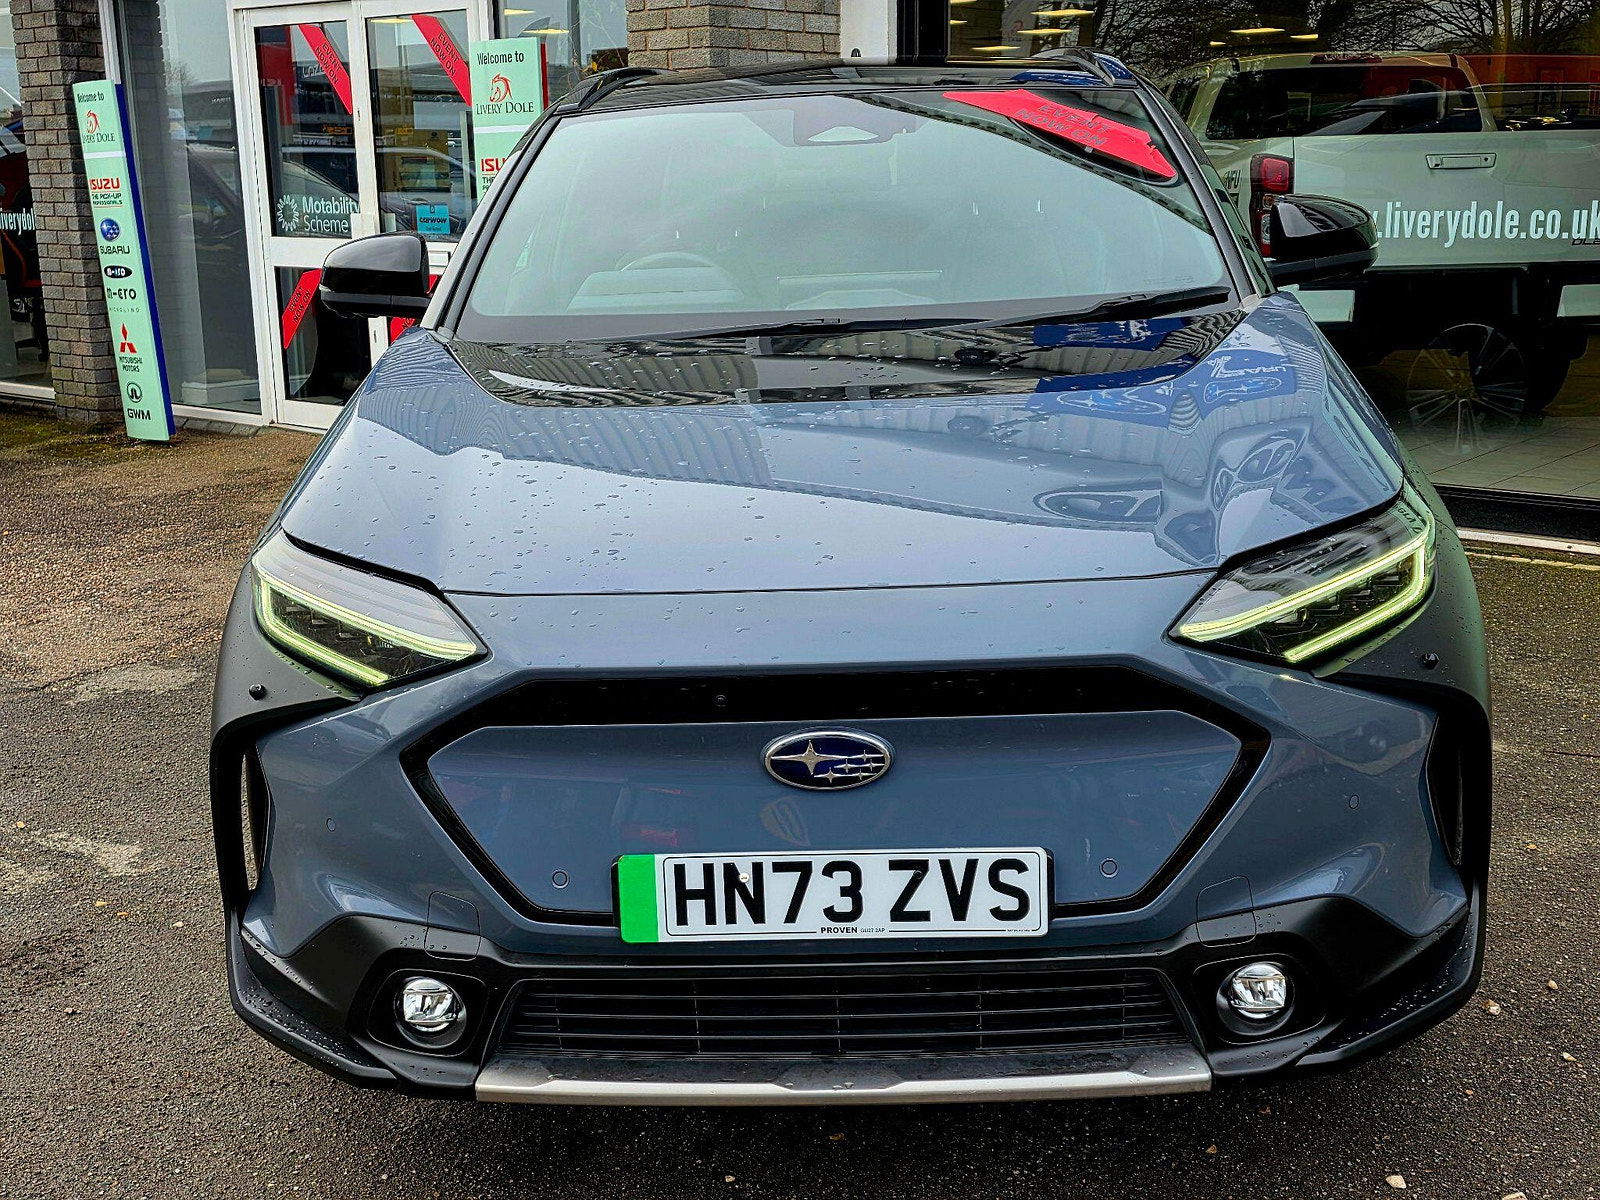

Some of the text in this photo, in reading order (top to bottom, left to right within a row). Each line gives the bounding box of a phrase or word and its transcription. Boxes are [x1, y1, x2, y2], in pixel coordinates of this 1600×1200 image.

[322, 43, 341, 71] EVENT
[430, 38, 456, 76] NOW ON
[438, 32, 460, 63] EVENT
[477, 50, 525, 65] Welcome to
[315, 47, 339, 84] NOW ON
[476, 102, 535, 115] LIVERY DOLE
[1038, 104, 1112, 132] EVENT
[1015, 108, 1110, 146] NOW ON
[302, 196, 360, 214] Motability
[303, 214, 349, 233] Scheme
[100, 245, 130, 255] SUBARU
[127, 408, 151, 420] GWM
[673, 858, 1030, 927] HN73 ZVS
[820, 926, 858, 934] PROVEN
